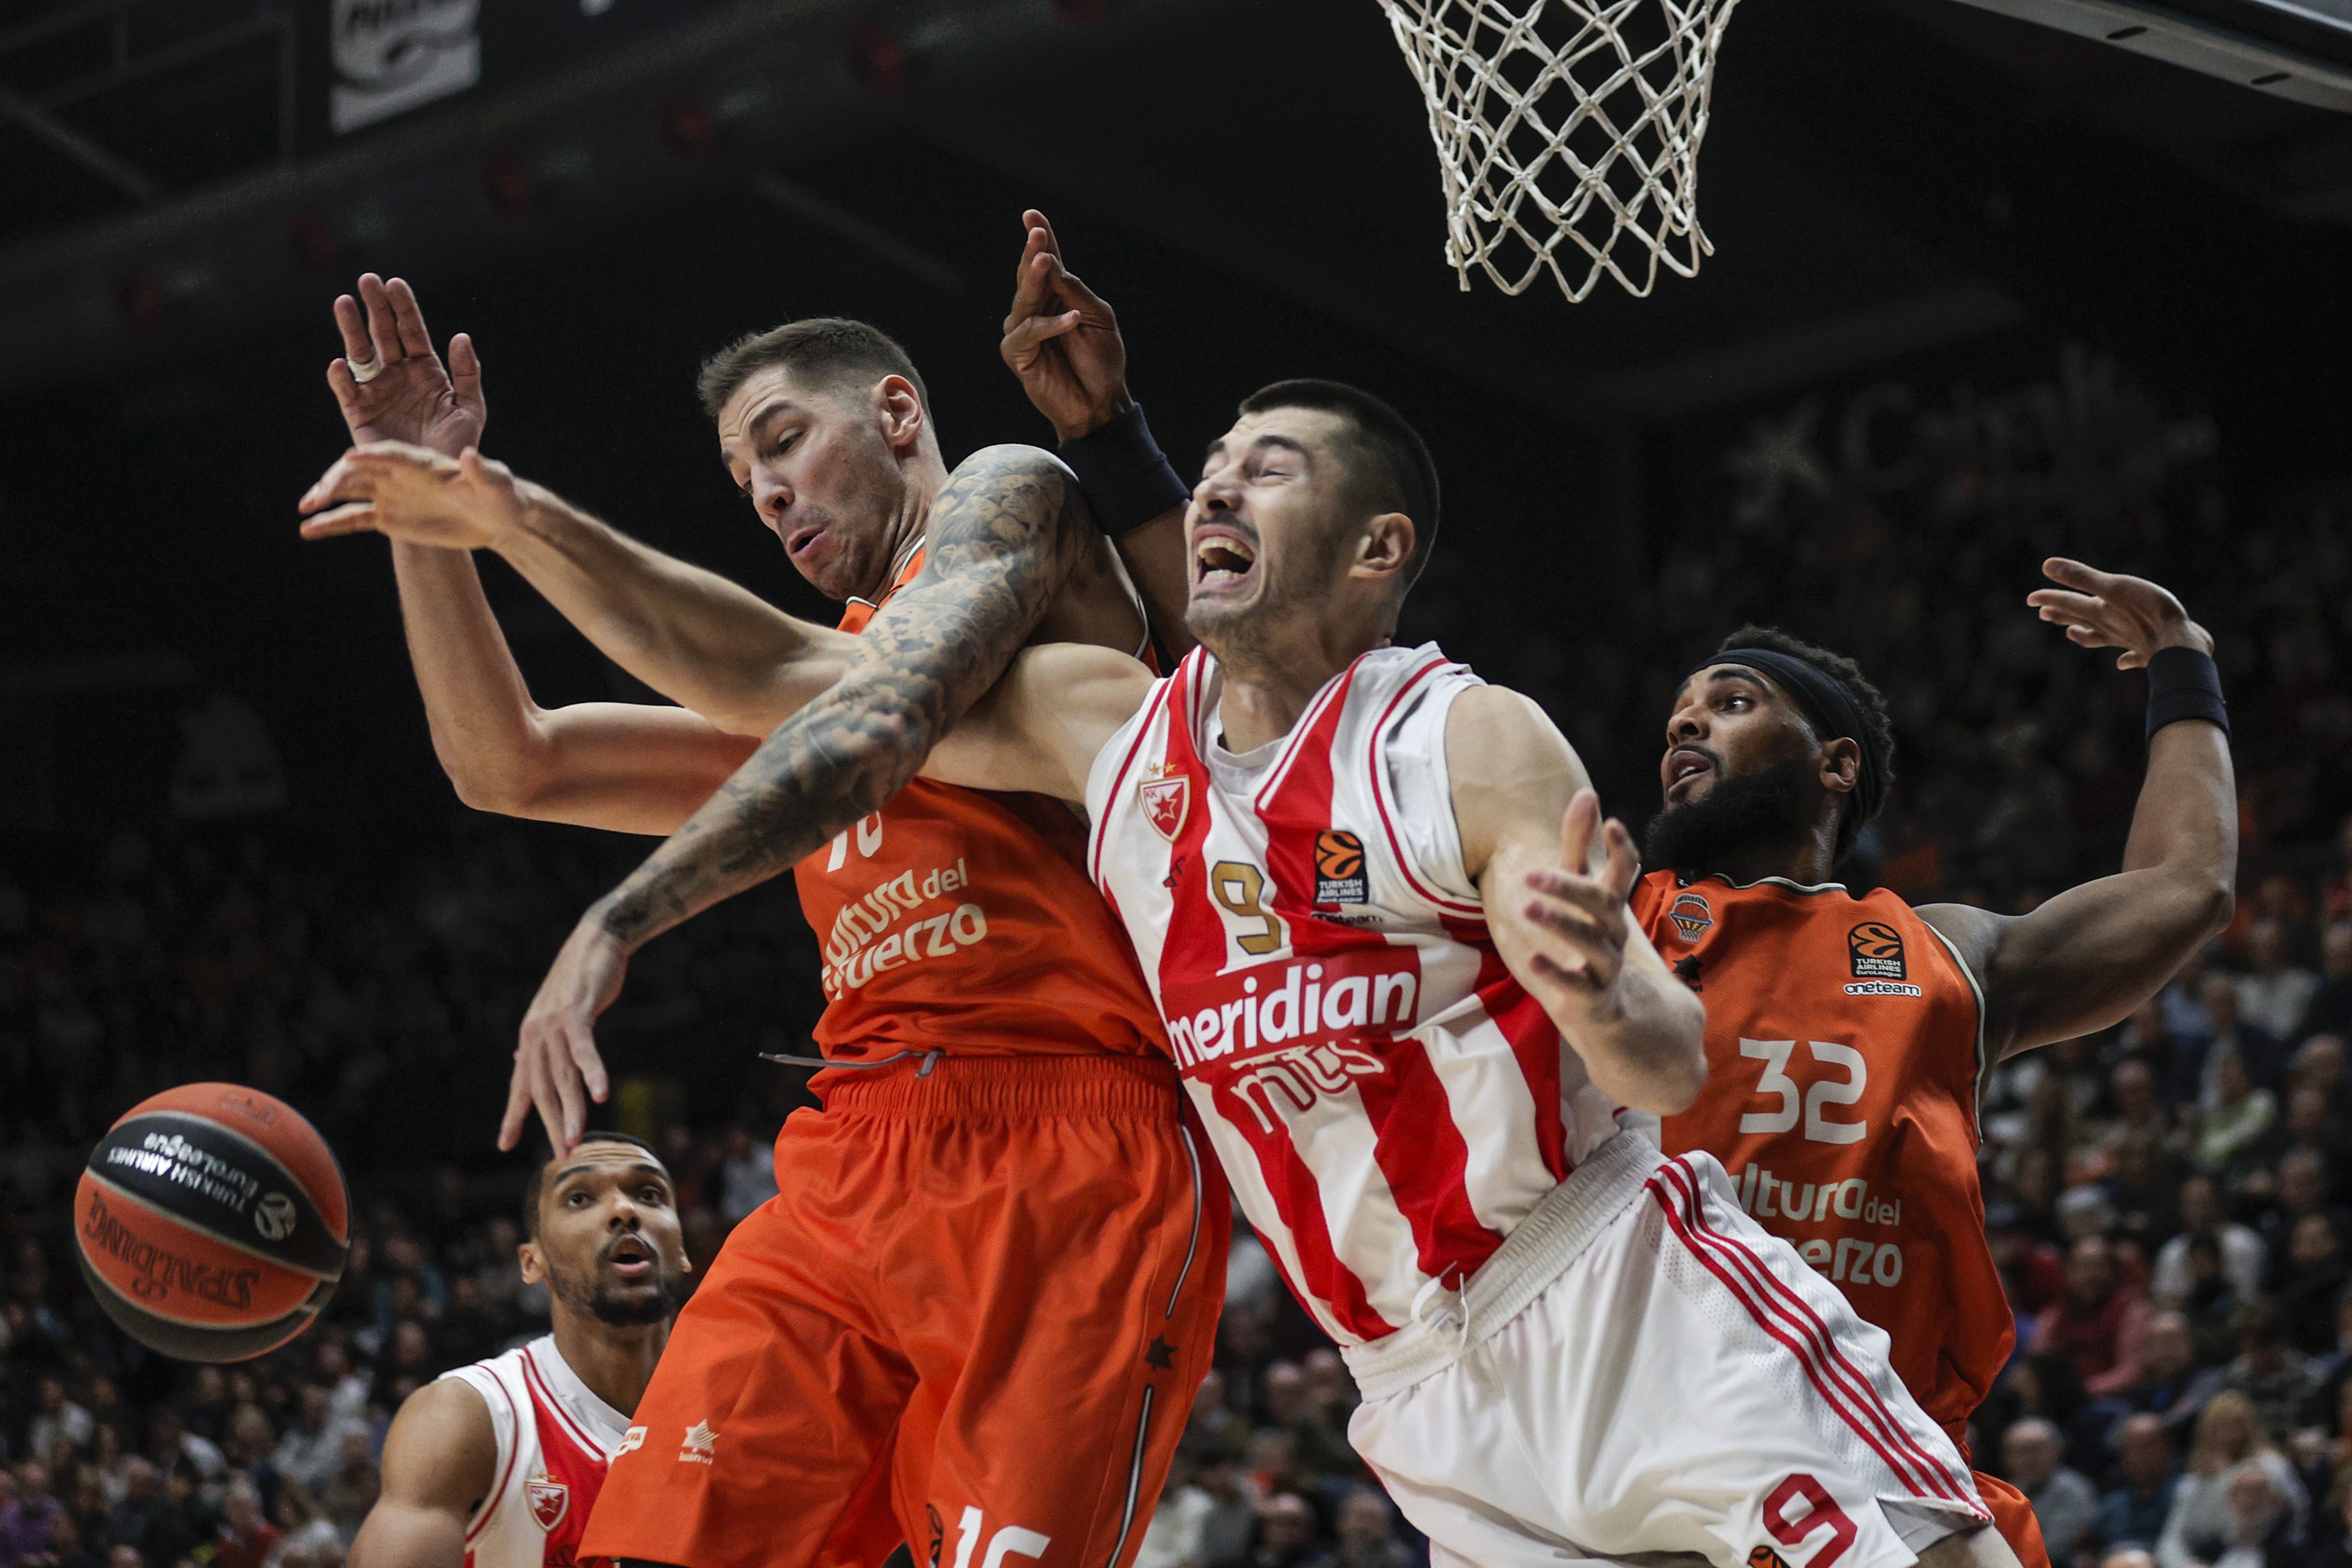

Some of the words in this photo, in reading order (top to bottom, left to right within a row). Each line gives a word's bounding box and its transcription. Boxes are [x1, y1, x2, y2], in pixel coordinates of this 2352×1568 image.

[826, 869, 924, 967] ultura
[922, 858, 968, 899] del
[1211, 860, 1281, 955] 9
[1845, 982, 1920, 995] oneteam
[1856, 959, 1901, 967] TURKISH
[1856, 965, 1902, 973] AIRLINES
[1168, 963, 1417, 1070] meridian
[1739, 1037, 1868, 1145] 32
[1729, 1162, 1868, 1222] ltura
[1865, 1196, 1901, 1226] del
[84, 1191, 259, 1310] SPALDING
[1762, 1473, 1858, 1568] 9
